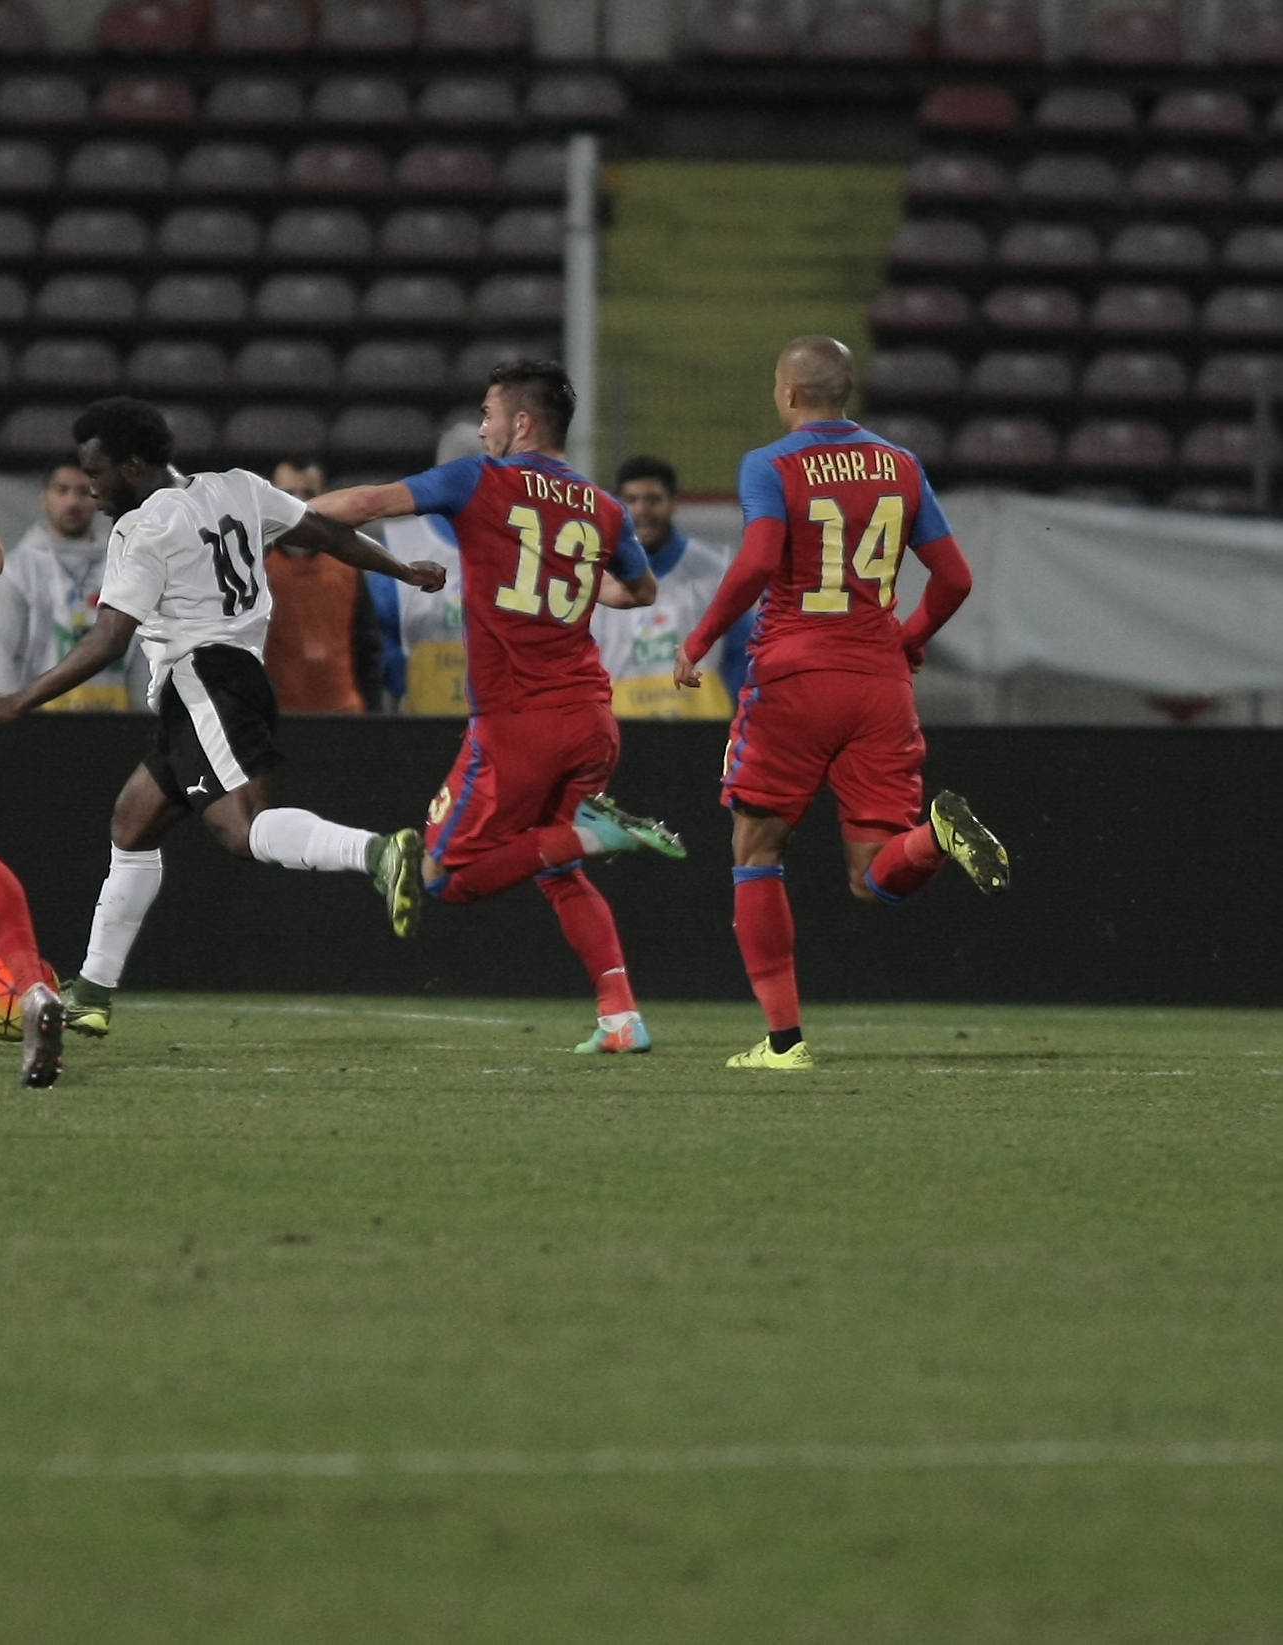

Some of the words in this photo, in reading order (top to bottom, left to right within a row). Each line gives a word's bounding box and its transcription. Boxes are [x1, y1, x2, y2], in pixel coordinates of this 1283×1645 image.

[520, 470, 595, 514] TOSCA
[802, 450, 897, 486] KHARJA
[198, 513, 260, 617] 10
[495, 505, 601, 624] 13
[801, 495, 904, 613] 14
